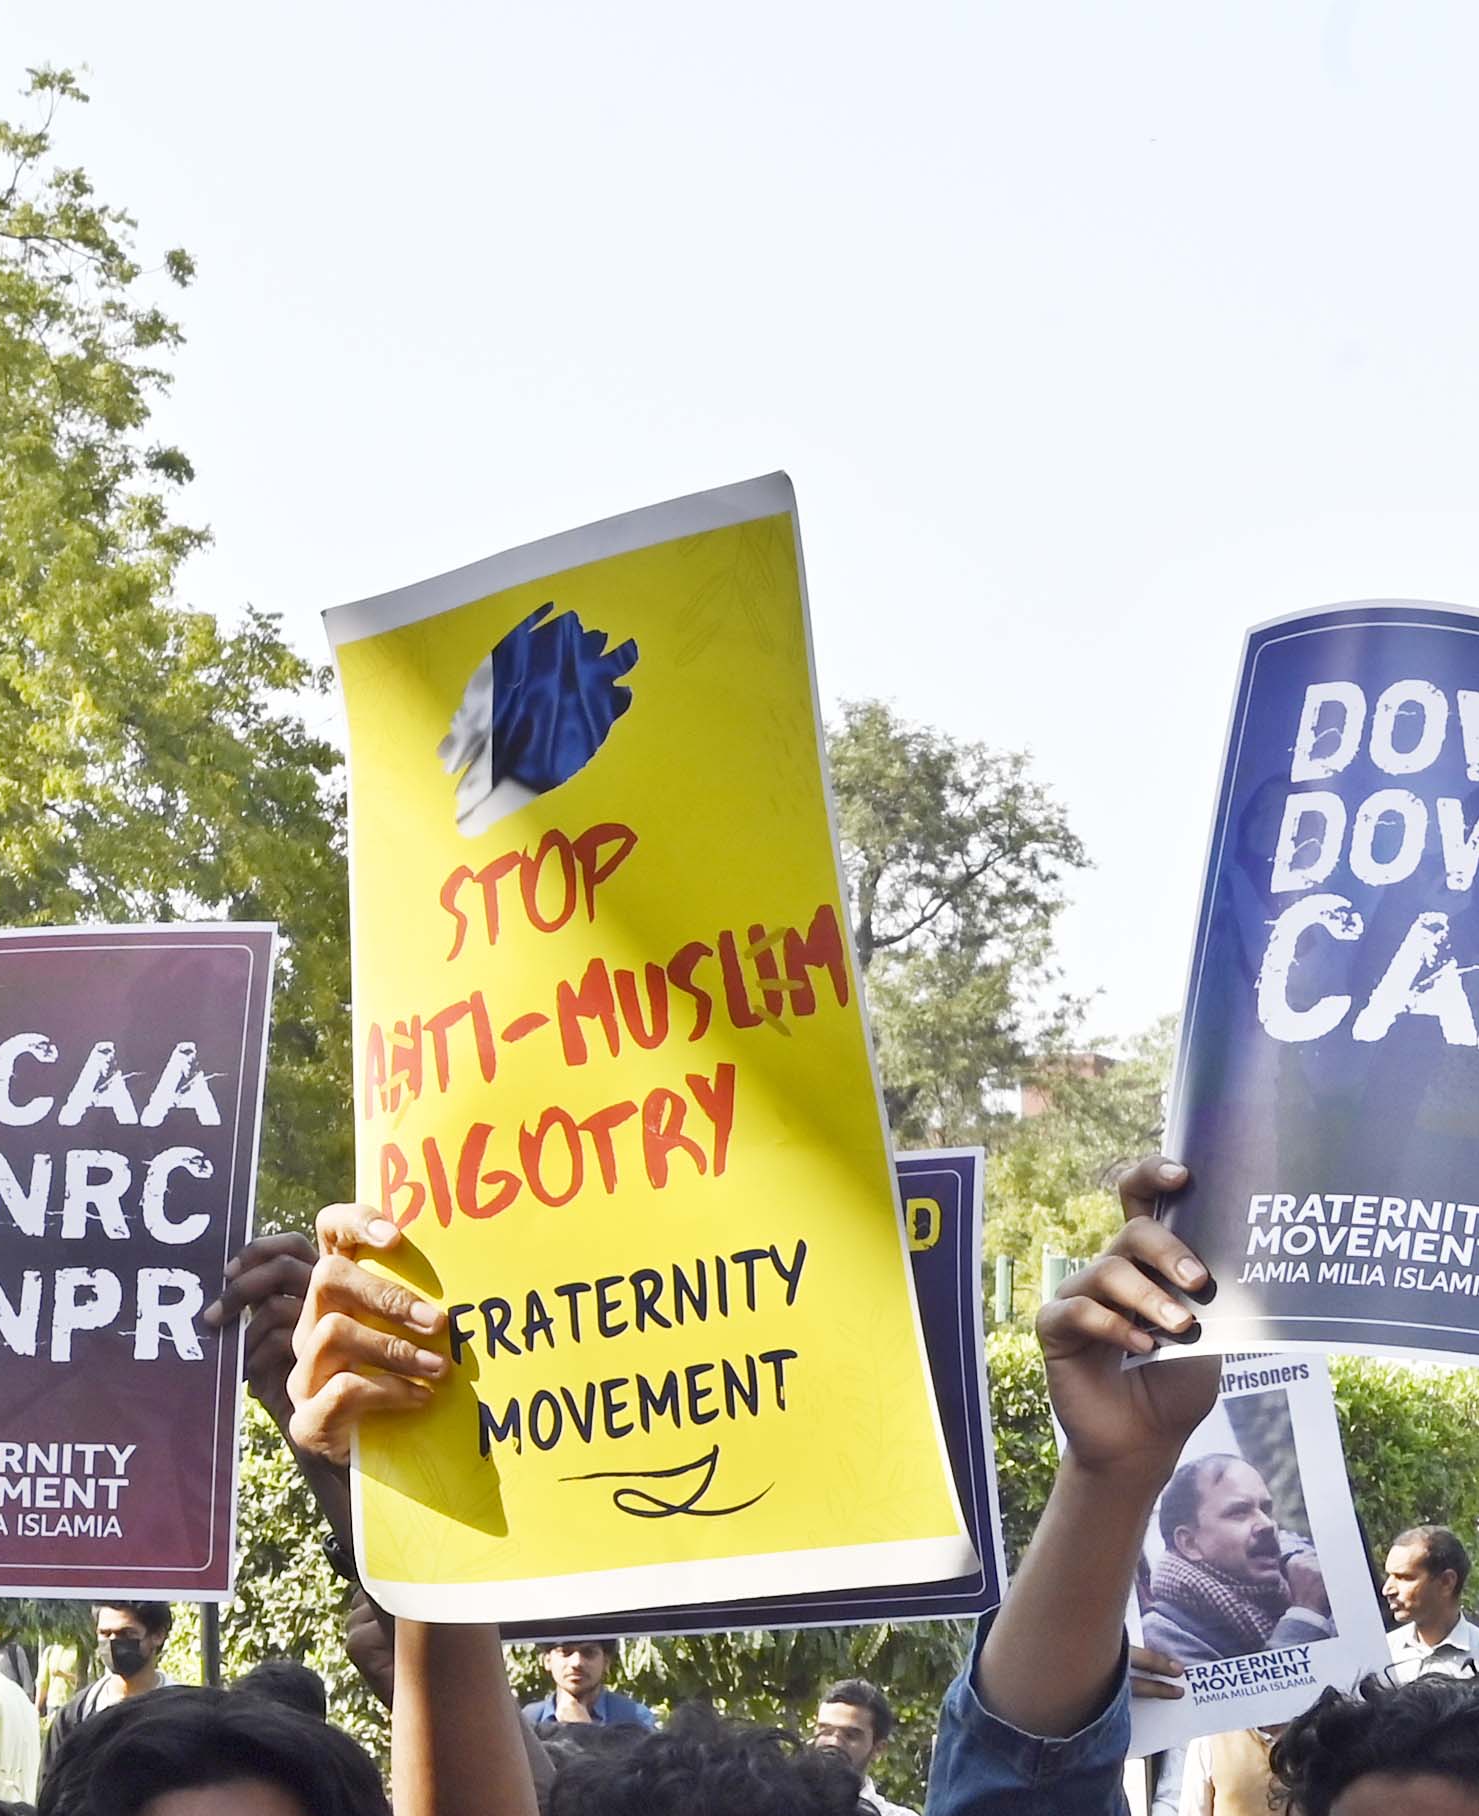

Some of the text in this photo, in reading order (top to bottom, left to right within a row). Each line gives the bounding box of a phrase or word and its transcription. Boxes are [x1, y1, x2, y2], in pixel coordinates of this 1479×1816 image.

[440, 823, 638, 961] STOP
[365, 904, 848, 1119] ANTI-MUSLIM
[381, 1062, 735, 1230] BIGOTRY
[449, 1239, 807, 1364] FRATERNITY
[1237, 1261, 1310, 1284] JAMIA
[1317, 1262, 1386, 1286] MILIA
[478, 1349, 797, 1459] MOVEMENT
[17, 1513, 123, 1538] ISLAMIA
[1184, 1646, 1310, 1681] FRATERNITY
[1191, 1660, 1311, 1694] MOVEMENT
[1193, 1675, 1317, 1706] JAMIA MILLIA ISLAMIA
